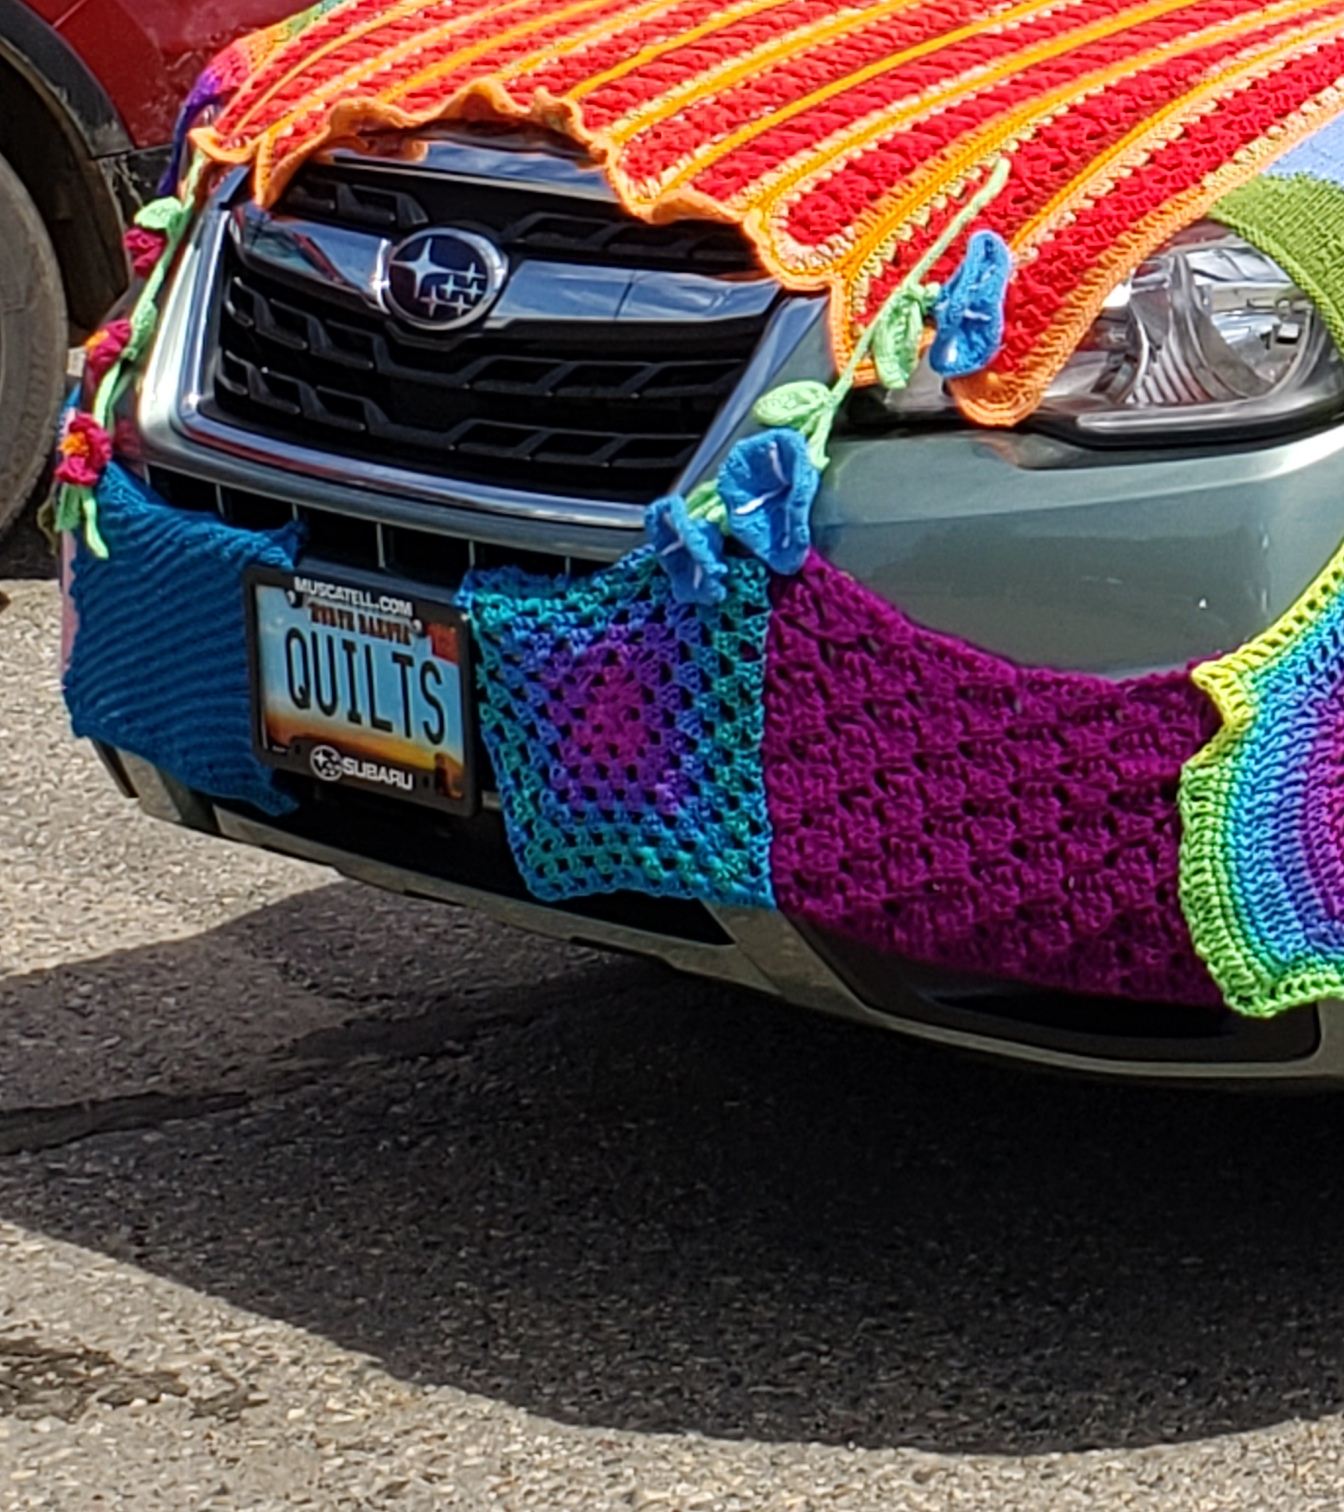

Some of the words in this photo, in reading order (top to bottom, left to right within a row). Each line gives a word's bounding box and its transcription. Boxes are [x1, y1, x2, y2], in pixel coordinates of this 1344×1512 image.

[294, 576, 413, 617] MUSCATELL.COM
[285, 627, 446, 745] QUILTS
[340, 757, 414, 790] SUBARU
